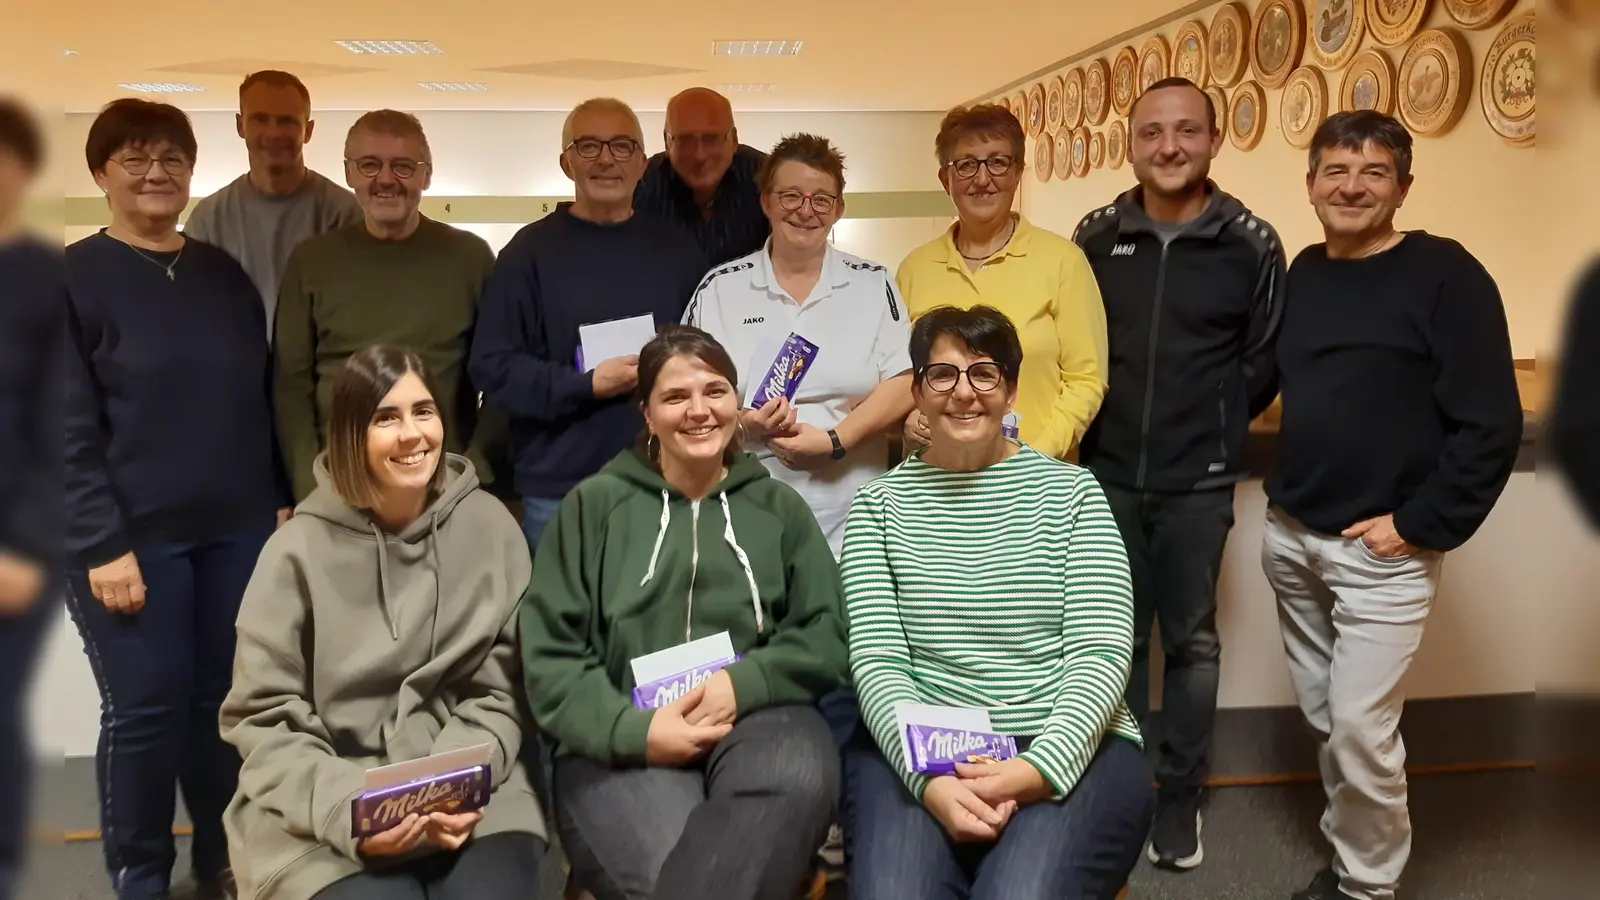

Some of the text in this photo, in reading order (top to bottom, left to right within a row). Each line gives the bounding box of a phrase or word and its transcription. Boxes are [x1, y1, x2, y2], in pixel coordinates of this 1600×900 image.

[444, 203, 450, 213] 4
[542, 203, 548, 213] 5
[1110, 243, 1136, 256] JAKO
[743, 317, 764, 325] JAKO
[764, 355, 790, 401] Milka
[927, 731, 988, 760] Milka
[373, 781, 455, 823] Milka
